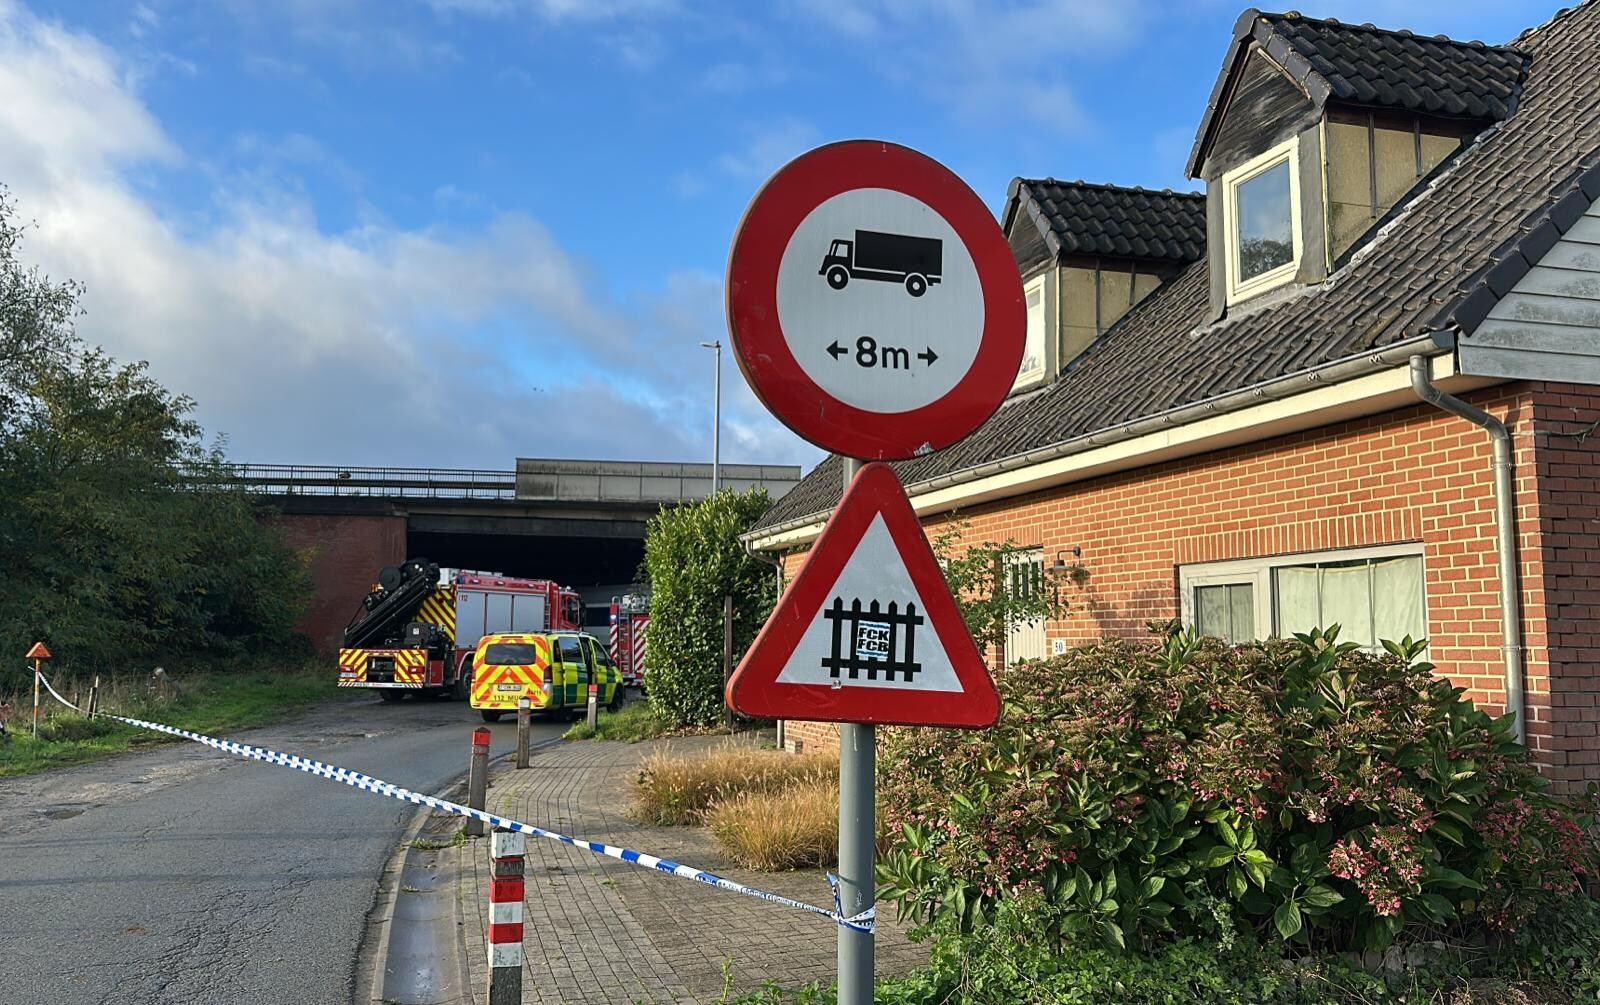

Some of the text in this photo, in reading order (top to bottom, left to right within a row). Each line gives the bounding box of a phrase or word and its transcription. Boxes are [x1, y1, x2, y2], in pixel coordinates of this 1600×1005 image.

[856, 336, 909, 370] 8m
[858, 627, 889, 641] FCK
[857, 638, 889, 652] FCB
[1055, 641, 1063, 652] 50
